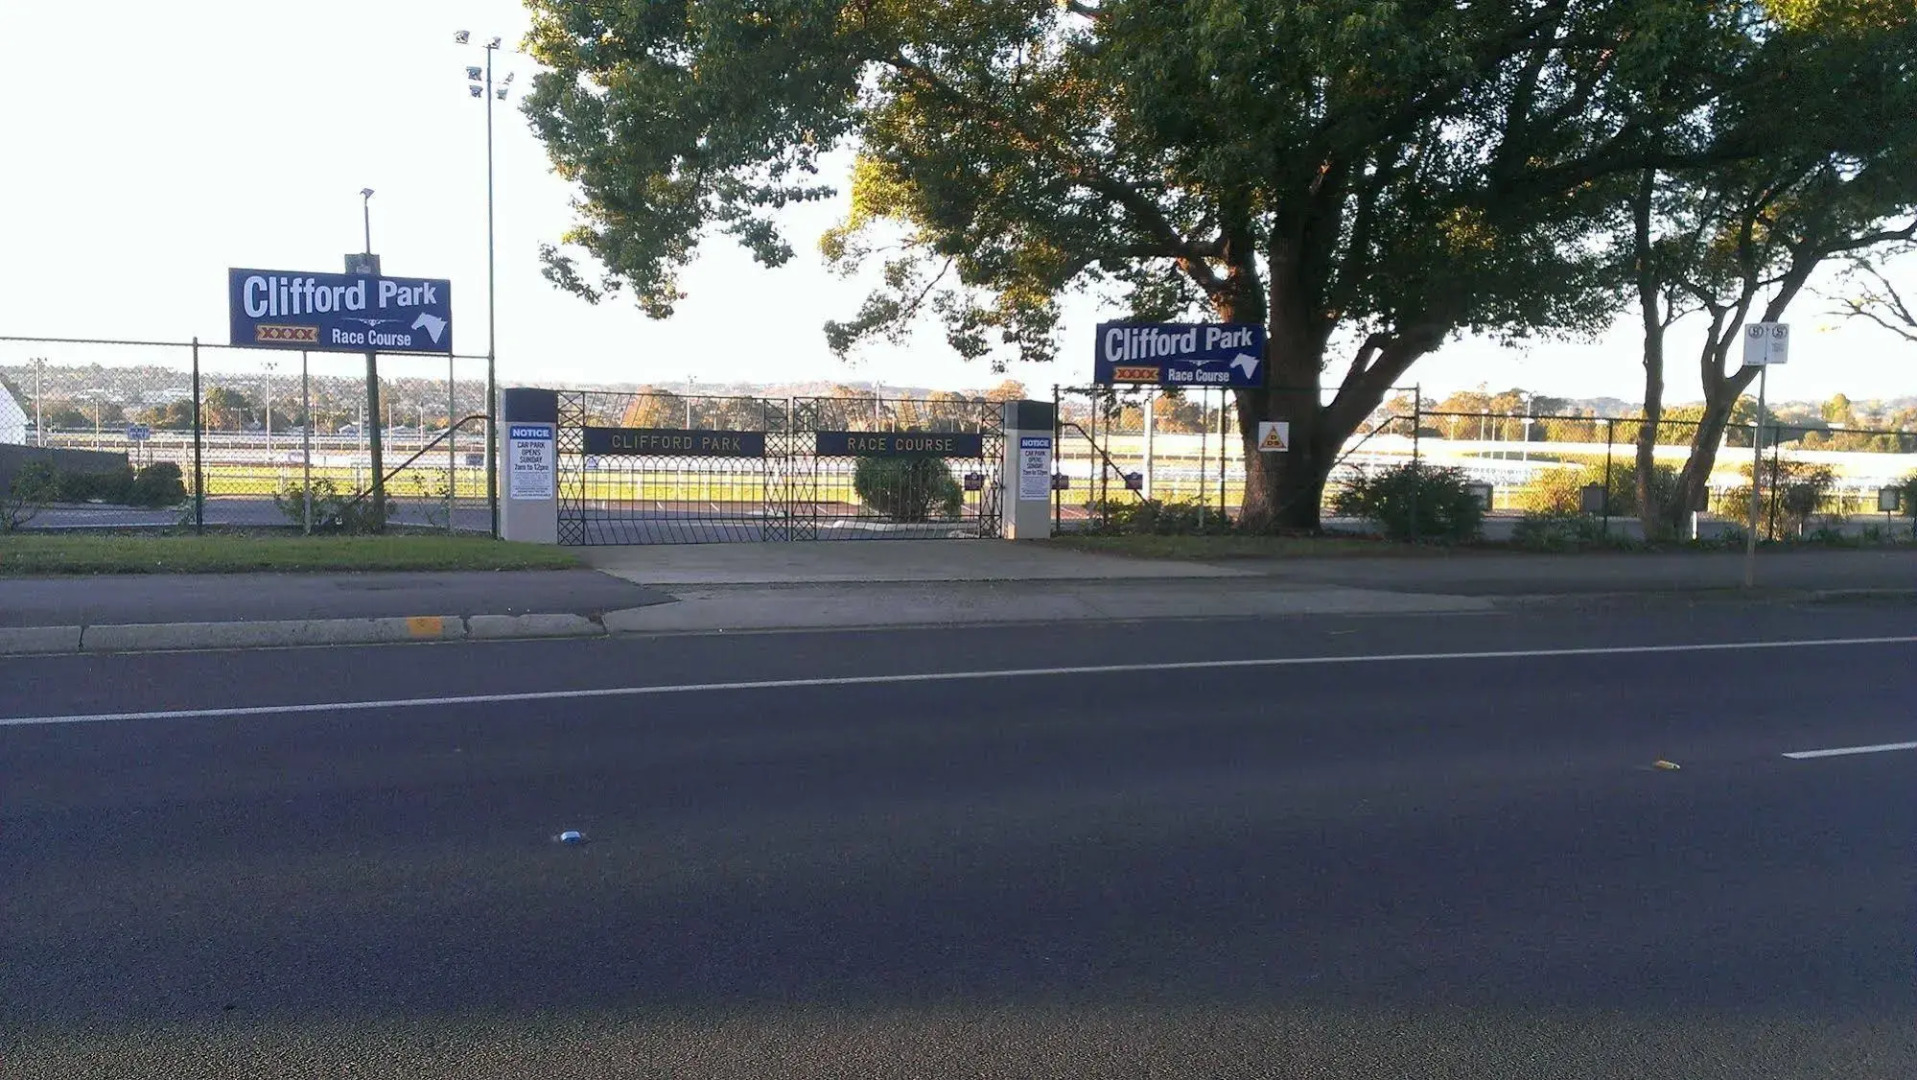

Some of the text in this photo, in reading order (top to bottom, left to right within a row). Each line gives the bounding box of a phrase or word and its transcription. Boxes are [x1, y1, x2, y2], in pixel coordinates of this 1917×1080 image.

[243, 275, 437, 318] Clifford Park
[259, 325, 316, 341] XXXX
[332, 328, 411, 347] Race Course
[1105, 326, 1253, 362] Clifford Park
[1116, 367, 1158, 380] XXXX
[1168, 368, 1230, 382] Race Course
[512, 428, 549, 438] NOTICE
[517, 441, 546, 449] CAR PARK
[611, 434, 742, 451] CLIFFORD PARK
[847, 437, 954, 452] RACE COURSE
